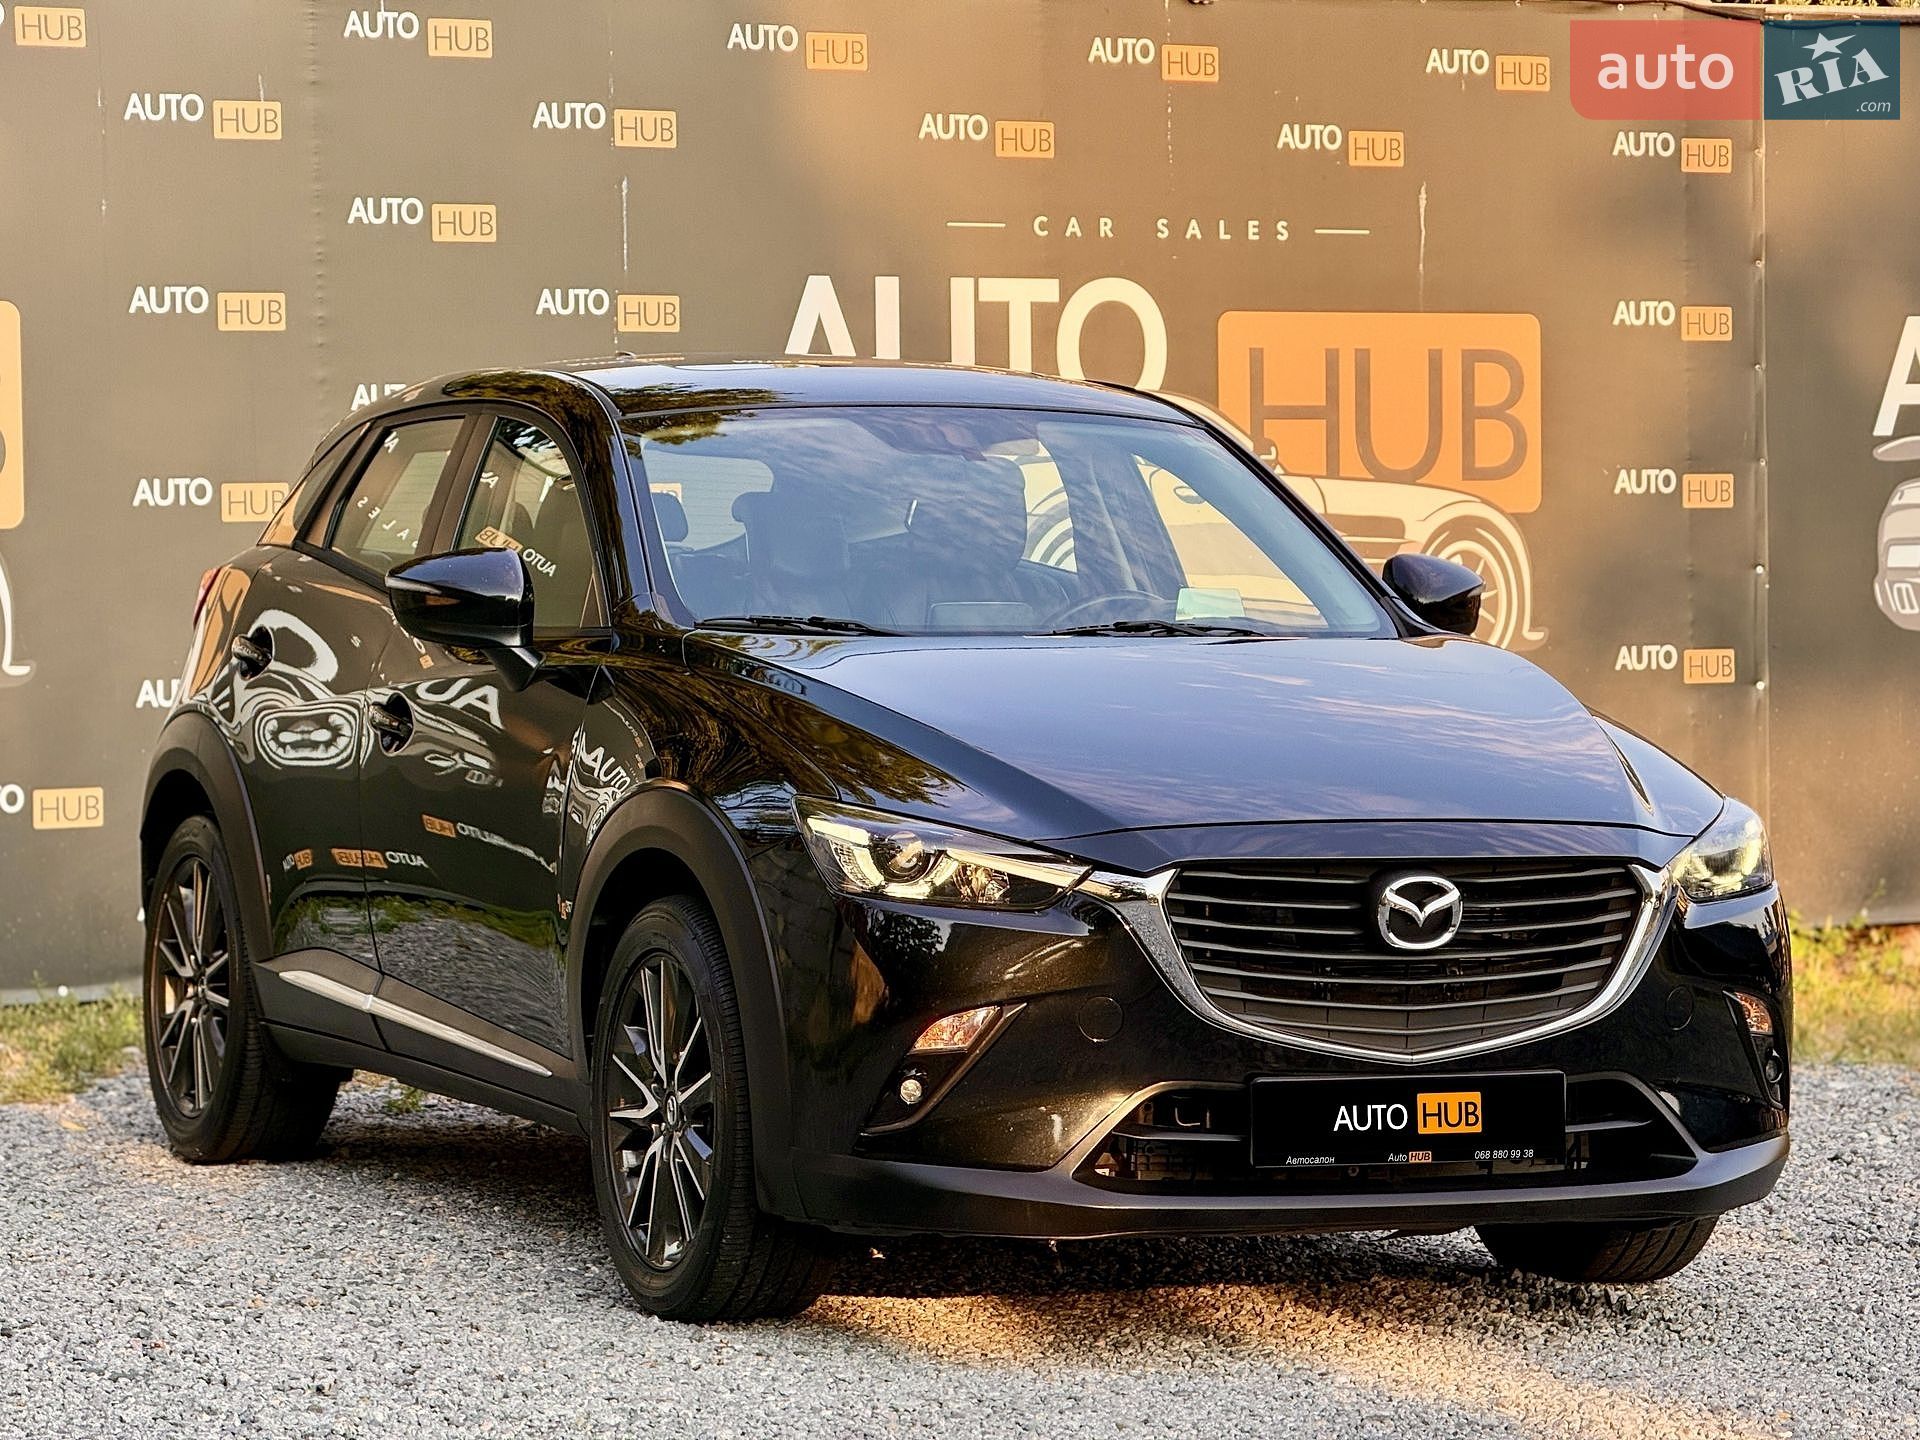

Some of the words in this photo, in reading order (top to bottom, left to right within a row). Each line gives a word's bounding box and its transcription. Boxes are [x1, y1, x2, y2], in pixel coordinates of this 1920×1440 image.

[21, 13, 83, 41] HUB
[344, 11, 419, 39] AUTO
[433, 26, 490, 53] HUB
[727, 24, 799, 52] AUTO
[812, 39, 865, 66] HUB
[1088, 38, 1155, 64] AUTO
[1167, 52, 1217, 77] HUB
[1426, 50, 1489, 75] AUTO
[1501, 60, 1548, 86] HUB
[124, 93, 204, 121] AUTO
[219, 108, 279, 134] HUB
[533, 102, 606, 129] AUTO
[620, 115, 674, 142] HUB
[918, 114, 988, 140] AUTO
[1001, 127, 1052, 153] HUB
[1278, 125, 1342, 150] AUTO
[1354, 136, 1401, 162] HUB
[1613, 132, 1675, 157] AUTO
[1686, 143, 1730, 168] HUB
[347, 197, 424, 225] AUTO
[438, 210, 494, 237] HUB
[1033, 216, 1114, 238] CAR
[1157, 218, 1289, 242] SALES
[129, 286, 209, 314] AUTO
[224, 299, 283, 326] HUB
[536, 288, 609, 315] AUTO
[623, 301, 677, 328] HUB
[1613, 302, 1675, 327] AUTO
[1686, 311, 1730, 336] HUB
[784, 275, 1168, 393] AUTO
[1248, 346, 1528, 480] HUB
[133, 478, 213, 507] AUTO
[1615, 470, 1676, 495] AUTO
[1688, 479, 1731, 503] HUB
[1615, 645, 1677, 670] AUTO
[1689, 655, 1733, 678] HUB
[39, 796, 99, 822] HUB
[1334, 1104, 1408, 1131] AUTO
[1422, 1102, 1480, 1128] HUB
[1286, 1155, 1335, 1165] Автосалон
[1388, 1153, 1407, 1162] Auto
[1410, 1152, 1431, 1162] HUB
[1474, 1150, 1491, 1160] 068
[1493, 1150, 1508, 1159] 880
[1510, 1150, 1520, 1159] 99
[1523, 1149, 1534, 1158] 38
